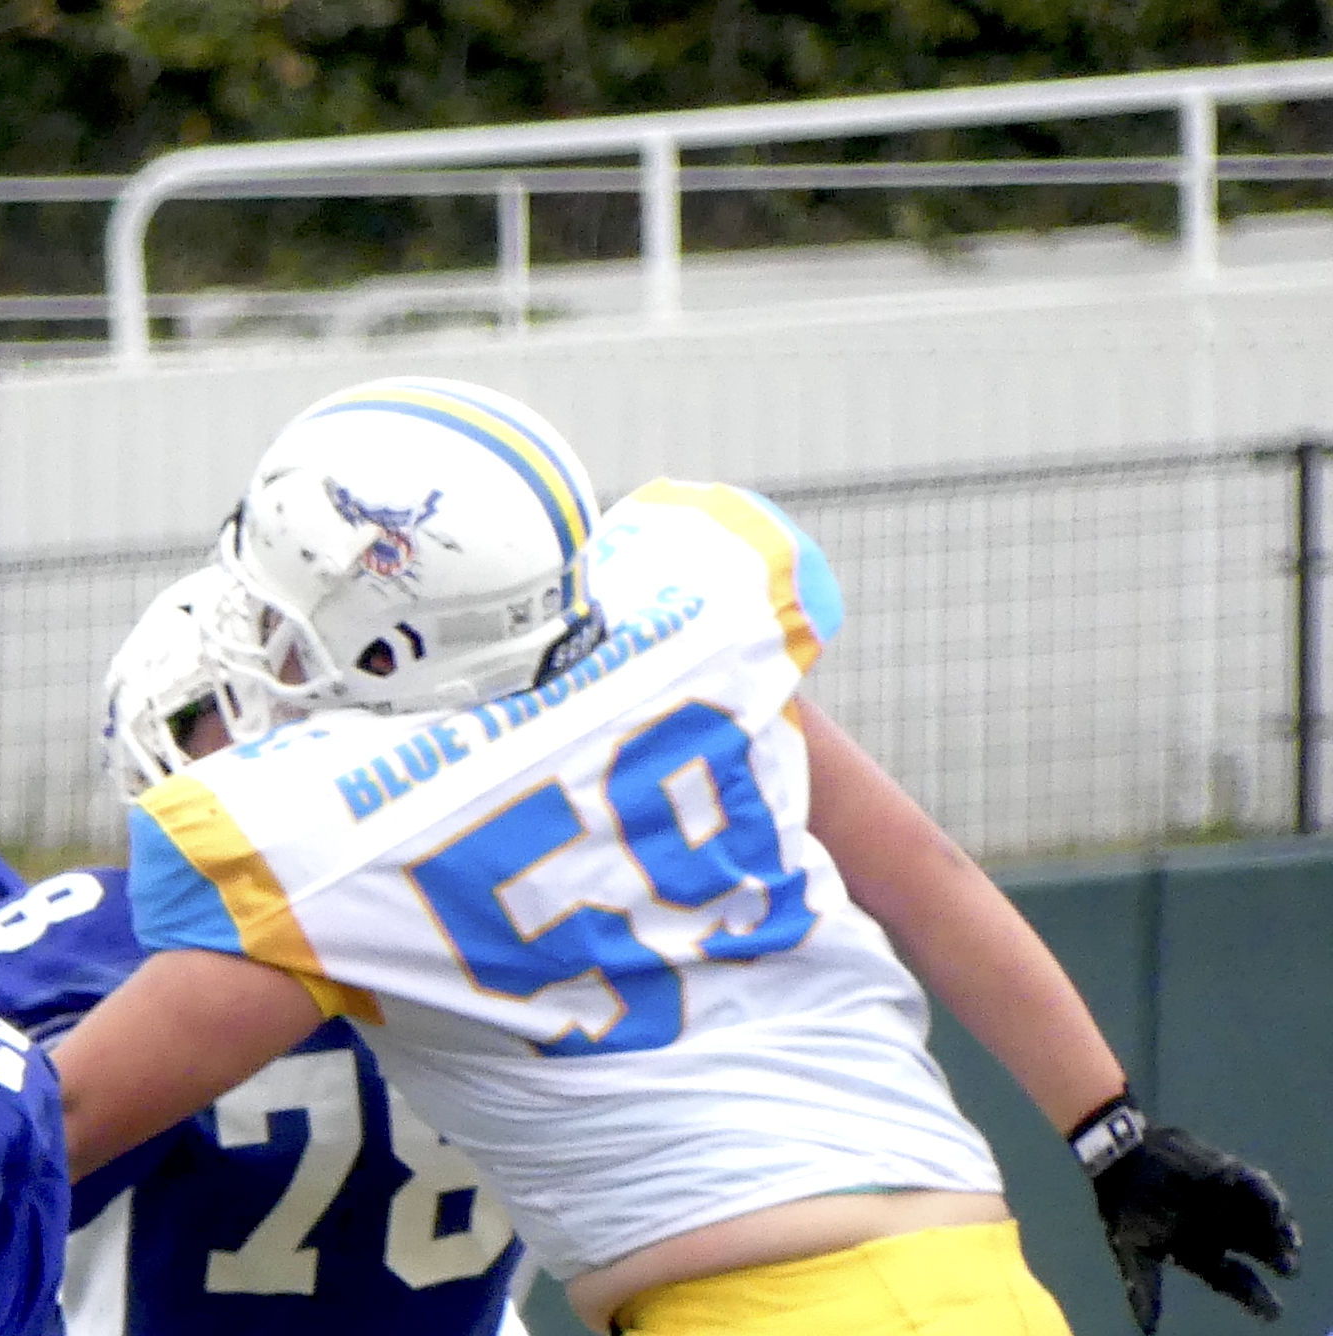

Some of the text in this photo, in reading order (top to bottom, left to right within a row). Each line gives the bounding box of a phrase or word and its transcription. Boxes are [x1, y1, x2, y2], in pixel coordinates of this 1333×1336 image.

[334, 723, 471, 823] BLUE
[474, 584, 706, 742] THUNDERS
[401, 696, 822, 1058] 59
[204, 1048, 515, 1296] 78
